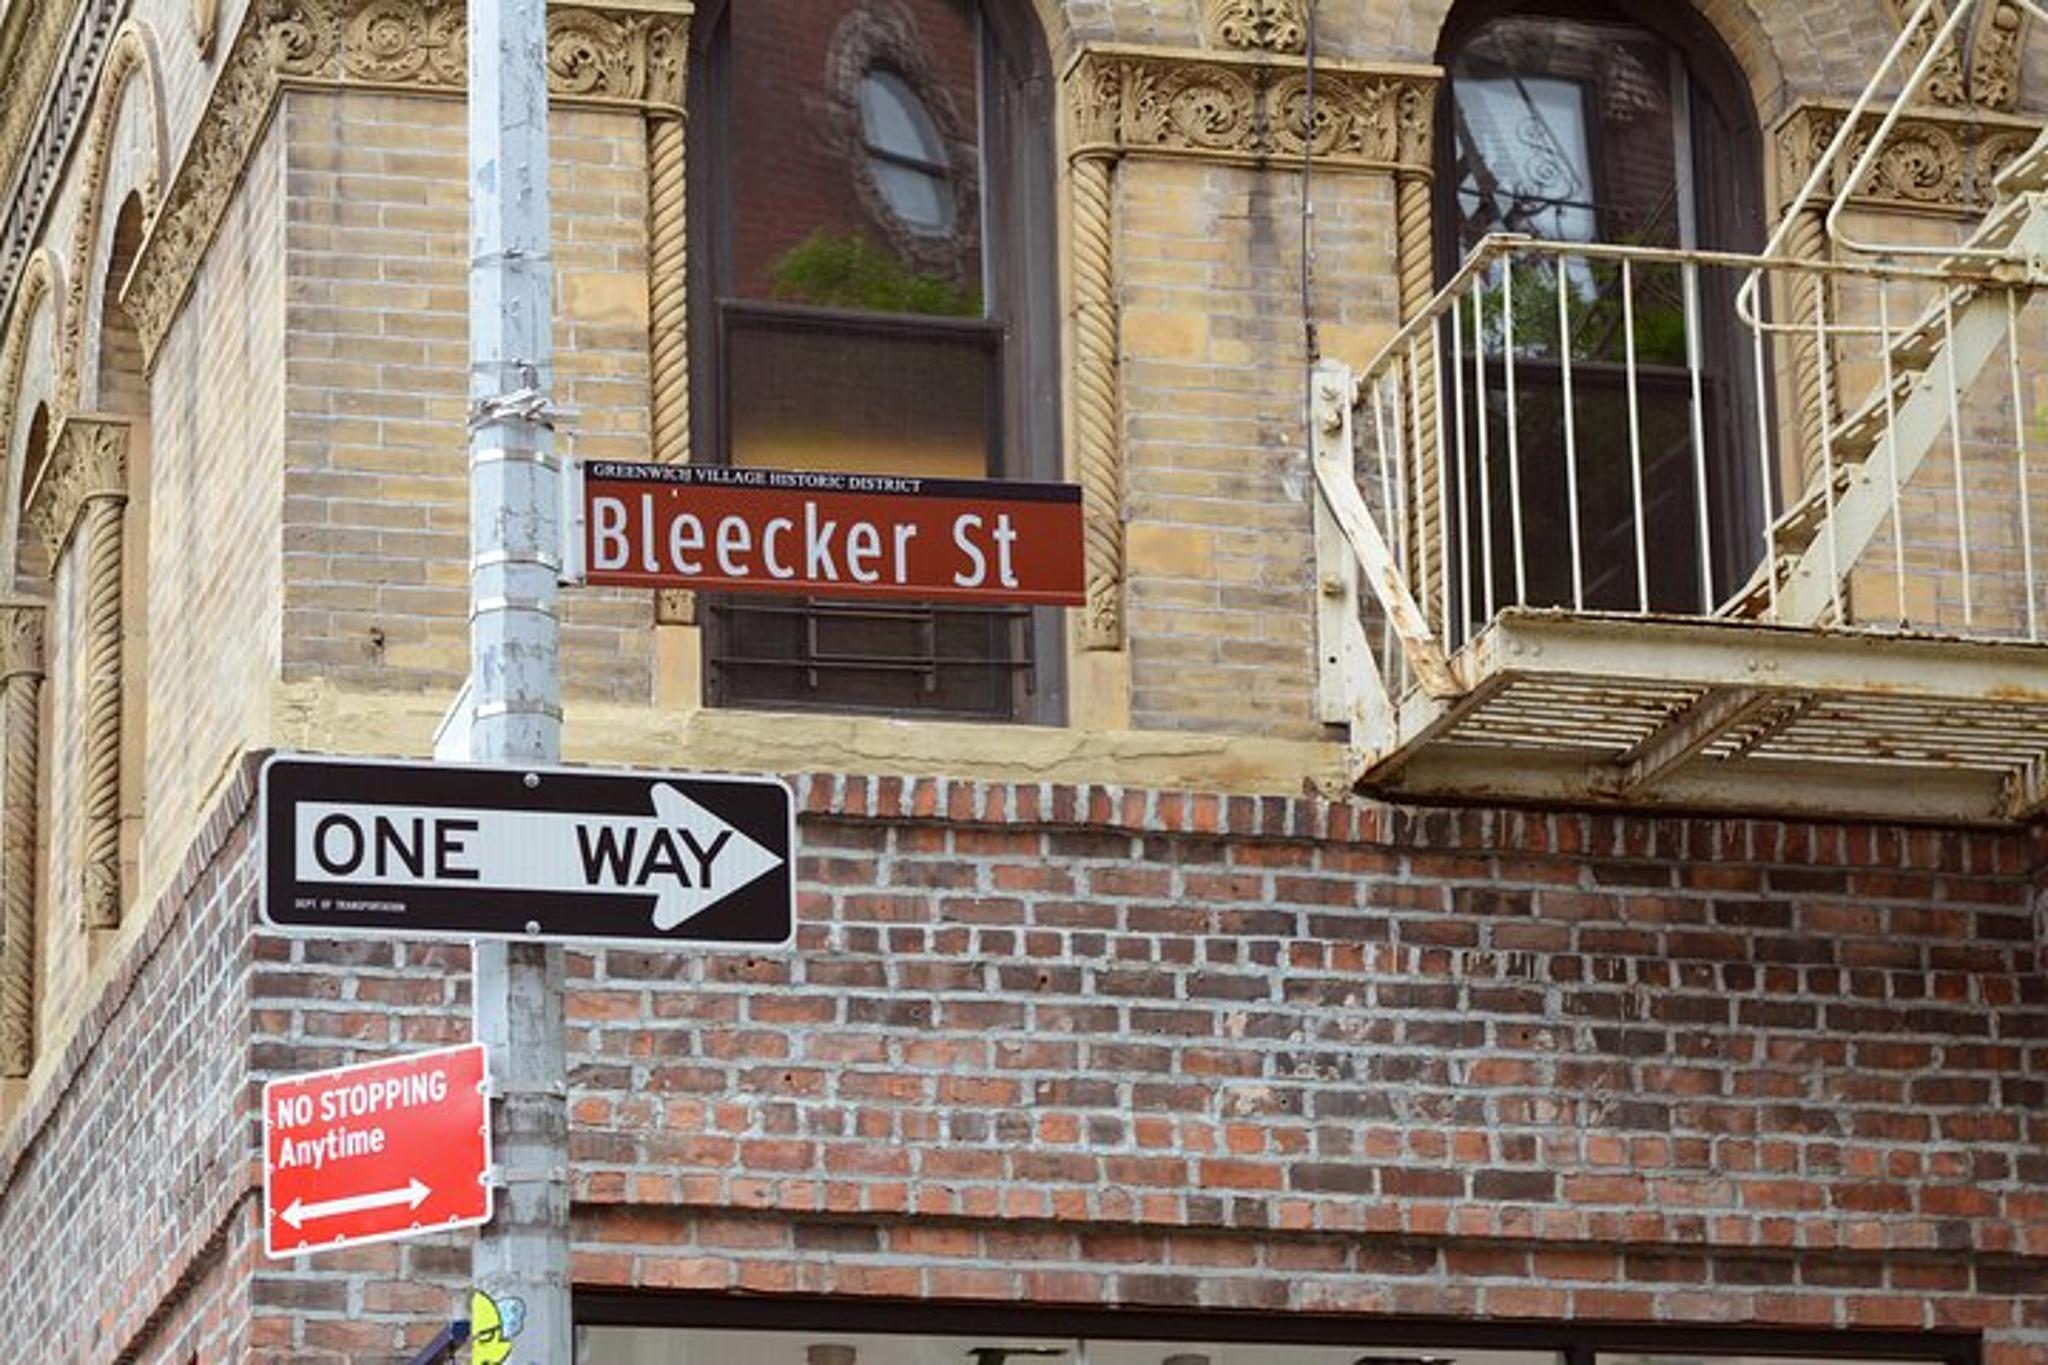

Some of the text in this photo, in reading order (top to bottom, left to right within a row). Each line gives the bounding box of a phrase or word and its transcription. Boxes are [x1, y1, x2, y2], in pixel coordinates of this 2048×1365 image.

[593, 464, 922, 493] GREENWICH VILLAGE HISTORIC DISTRICT
[592, 494, 1019, 588] Bleecker St
[313, 813, 733, 889] ONE WAY
[277, 1070, 447, 1130] NO STOPPING
[278, 1126, 385, 1169] Anytime
